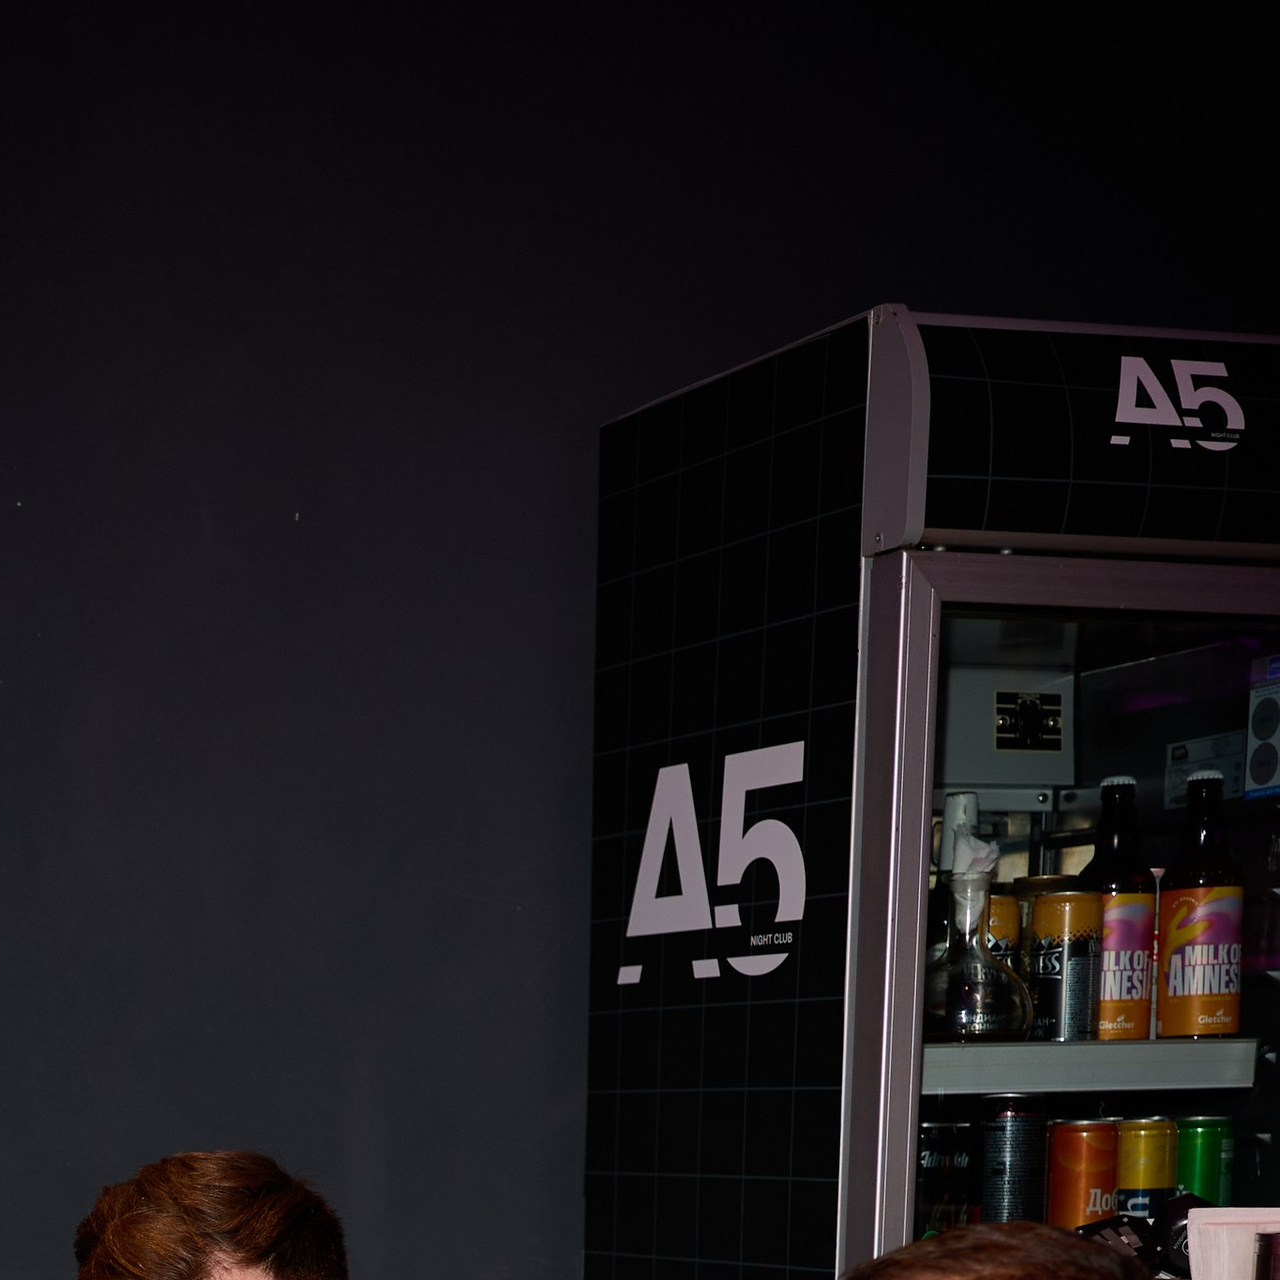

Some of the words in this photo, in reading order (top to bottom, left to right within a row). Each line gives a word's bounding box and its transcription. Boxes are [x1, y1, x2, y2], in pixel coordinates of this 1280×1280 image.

[1110, 356, 1245, 451] A5
[617, 740, 806, 985] A5
[750, 933, 772, 947] NIGHT
[773, 931, 793, 944] CLUB
[1103, 950, 1131, 971] ILK
[1184, 944, 1229, 966] MILK
